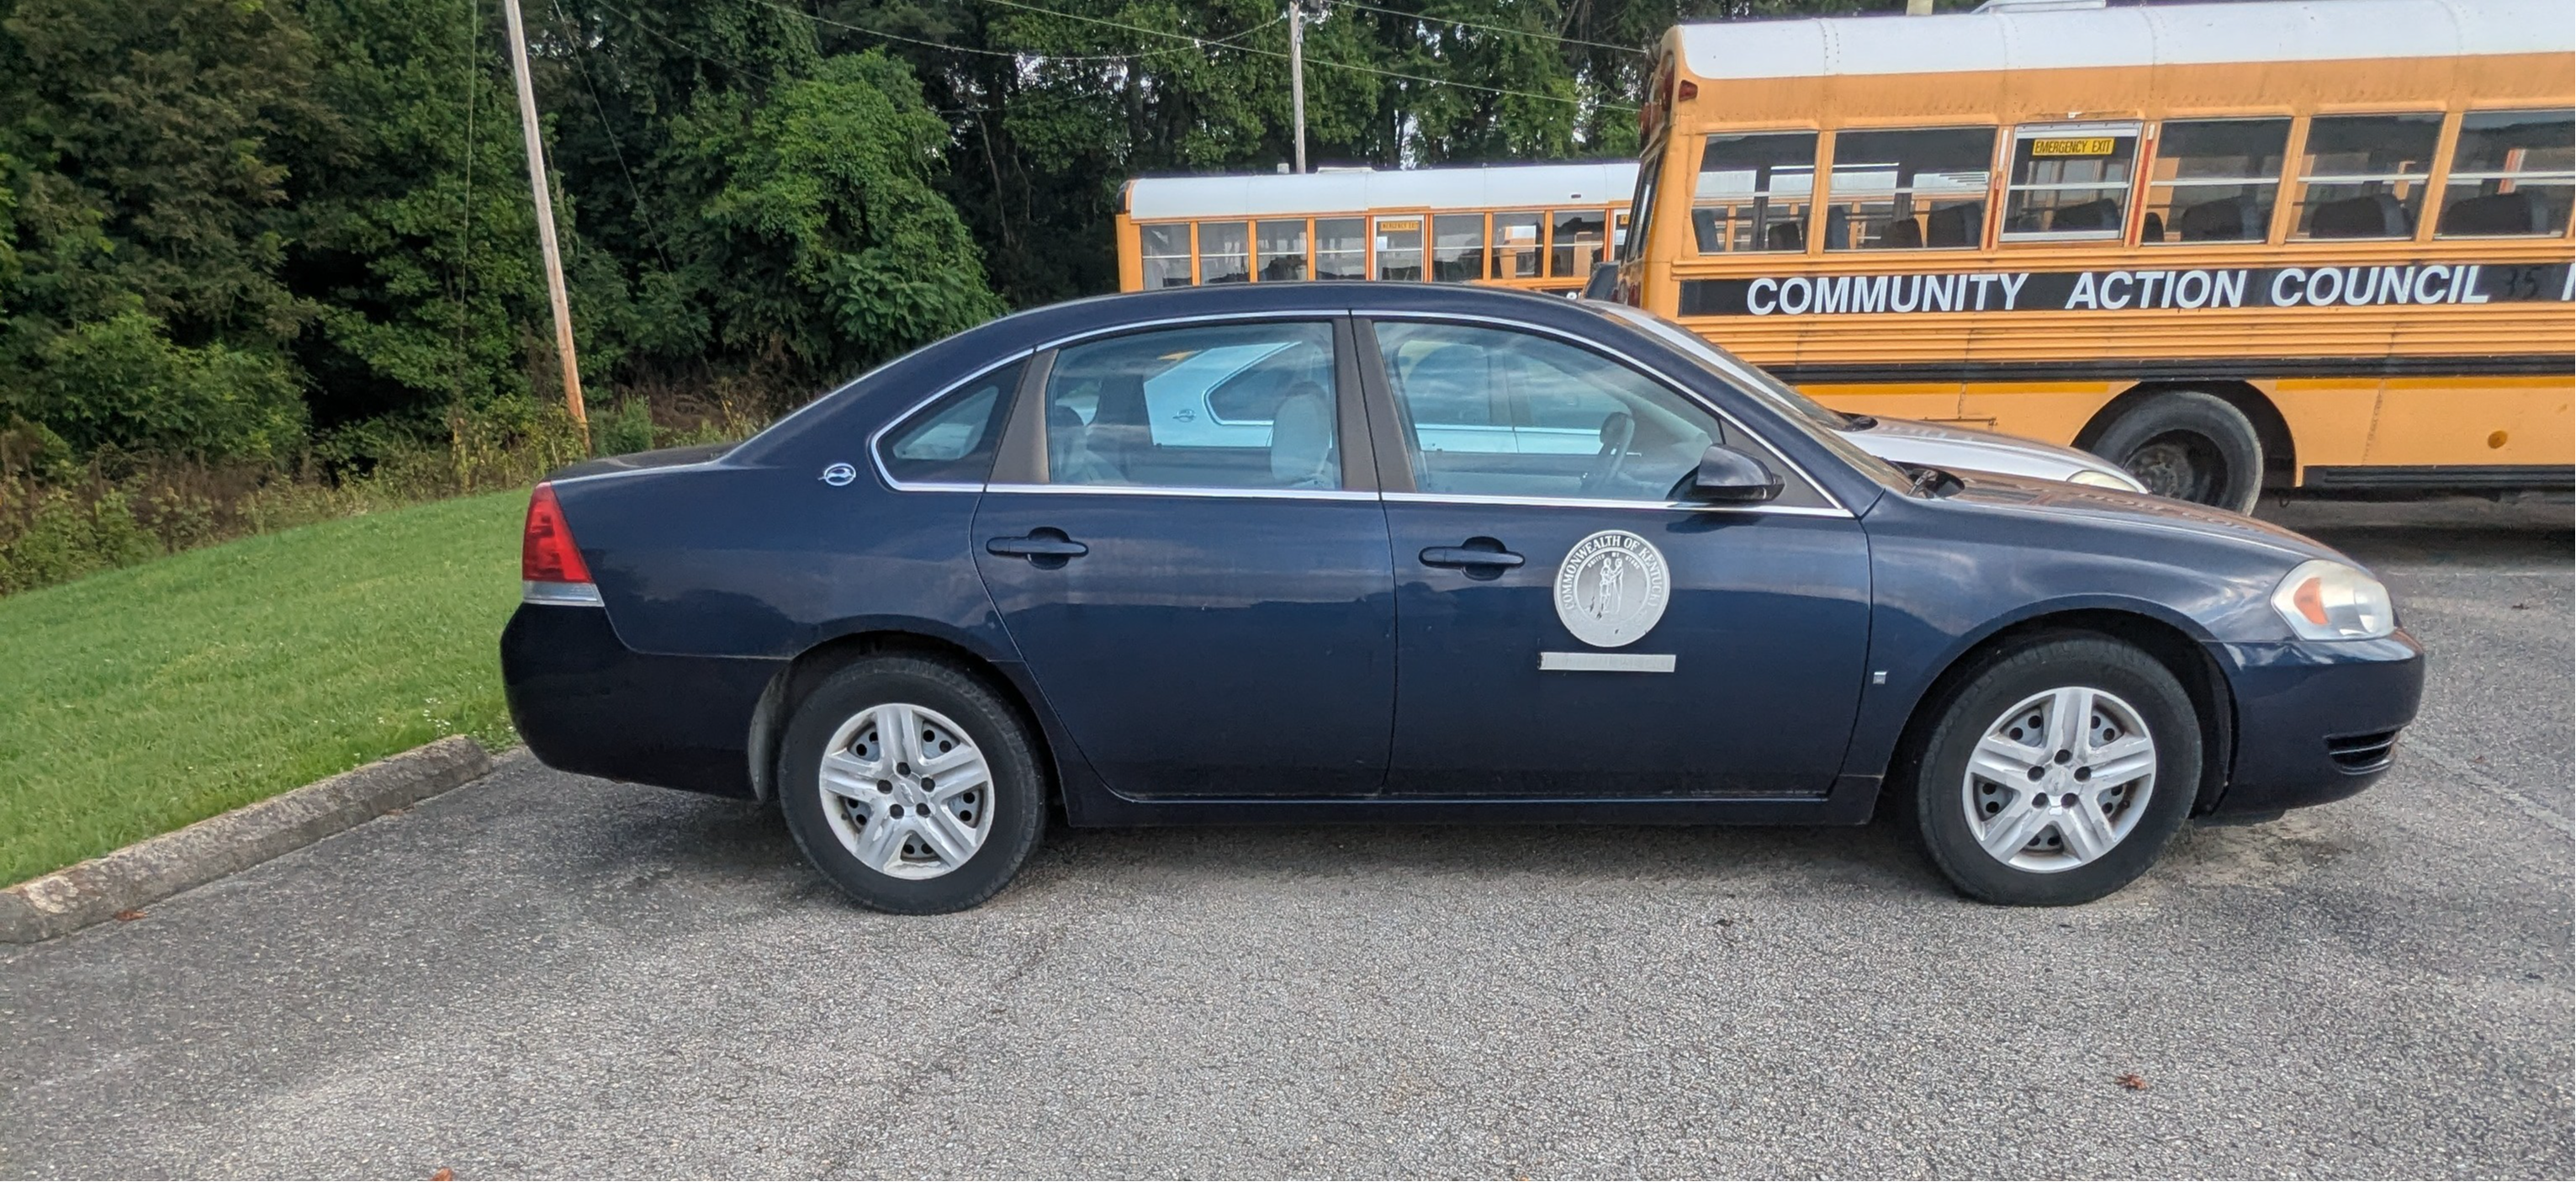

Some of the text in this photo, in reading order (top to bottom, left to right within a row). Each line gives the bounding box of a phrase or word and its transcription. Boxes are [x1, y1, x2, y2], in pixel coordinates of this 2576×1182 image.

[2035, 140, 2112, 154] EMERGENCY EXIT
[1747, 265, 2490, 315] COMMUNITY ACTION COUNCIL
[1562, 535, 1621, 609] COMMONWEALTH
[1623, 537, 1640, 551] OF
